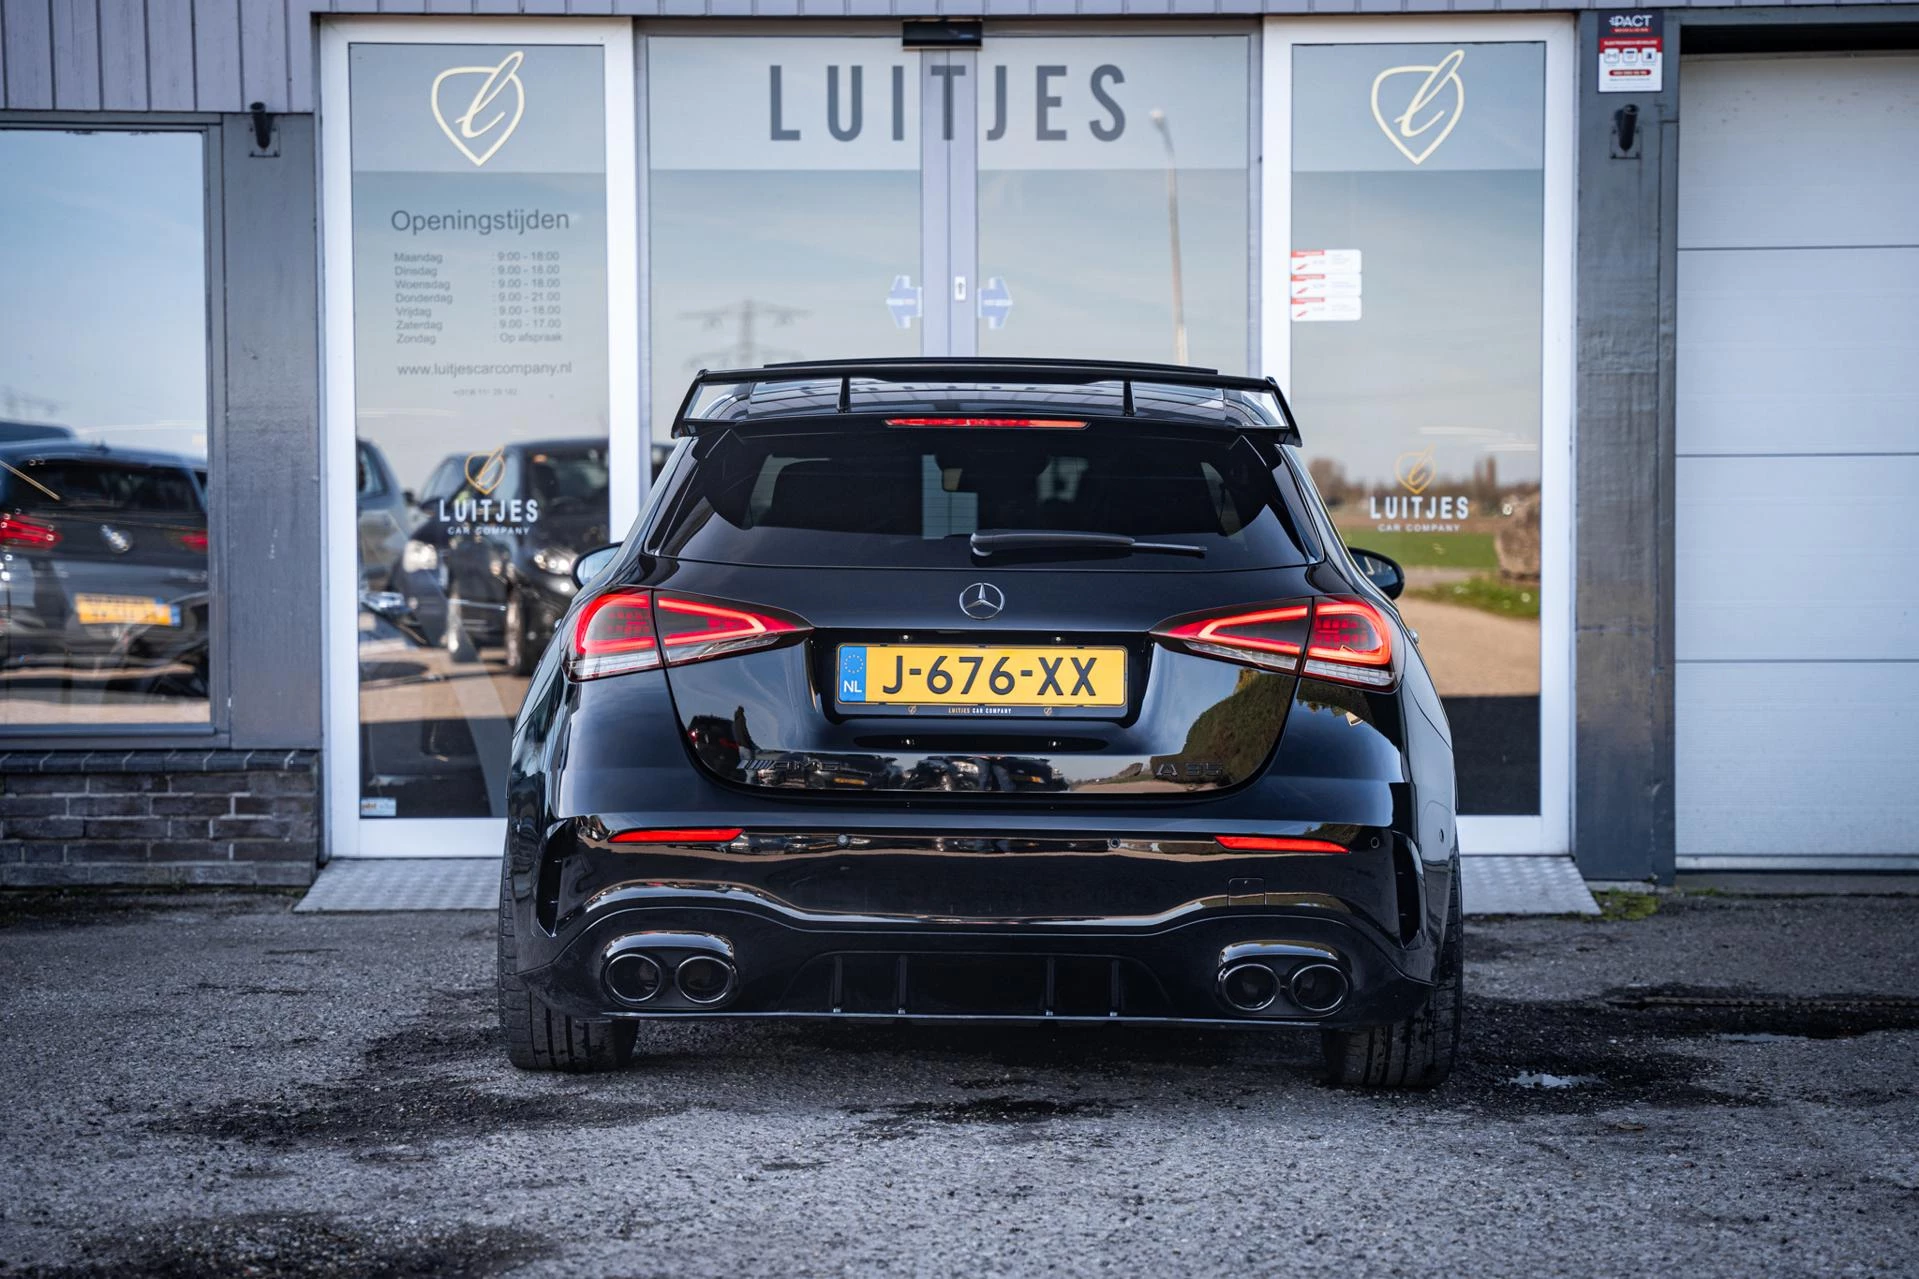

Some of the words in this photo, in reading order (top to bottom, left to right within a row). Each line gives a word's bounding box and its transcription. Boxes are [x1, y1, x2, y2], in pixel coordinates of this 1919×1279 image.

[769, 63, 1126, 142] LUITJES
[391, 208, 570, 236] Openingstijden
[394, 253, 443, 265] Maandag
[394, 266, 438, 278] Dinsdag
[394, 280, 450, 291] Woensdag
[395, 293, 453, 305] Donderdag
[395, 307, 432, 318] Vrijdag
[396, 320, 443, 332] Zaterdag
[396, 333, 436, 345] Zondag
[500, 332, 516, 343] Op
[518, 332, 562, 343] afspraak
[397, 361, 573, 378] www.luitjescarcompany.nl
[440, 499, 538, 522] LUITJES
[1370, 496, 1469, 519] LUITJES
[447, 526, 471, 535] CAR
[475, 526, 530, 535] COMPANY
[1377, 523, 1401, 532] CAR
[1405, 523, 1460, 532] COMPANY
[882, 655, 1097, 696] J-676-XX
[843, 680, 862, 693] NL
